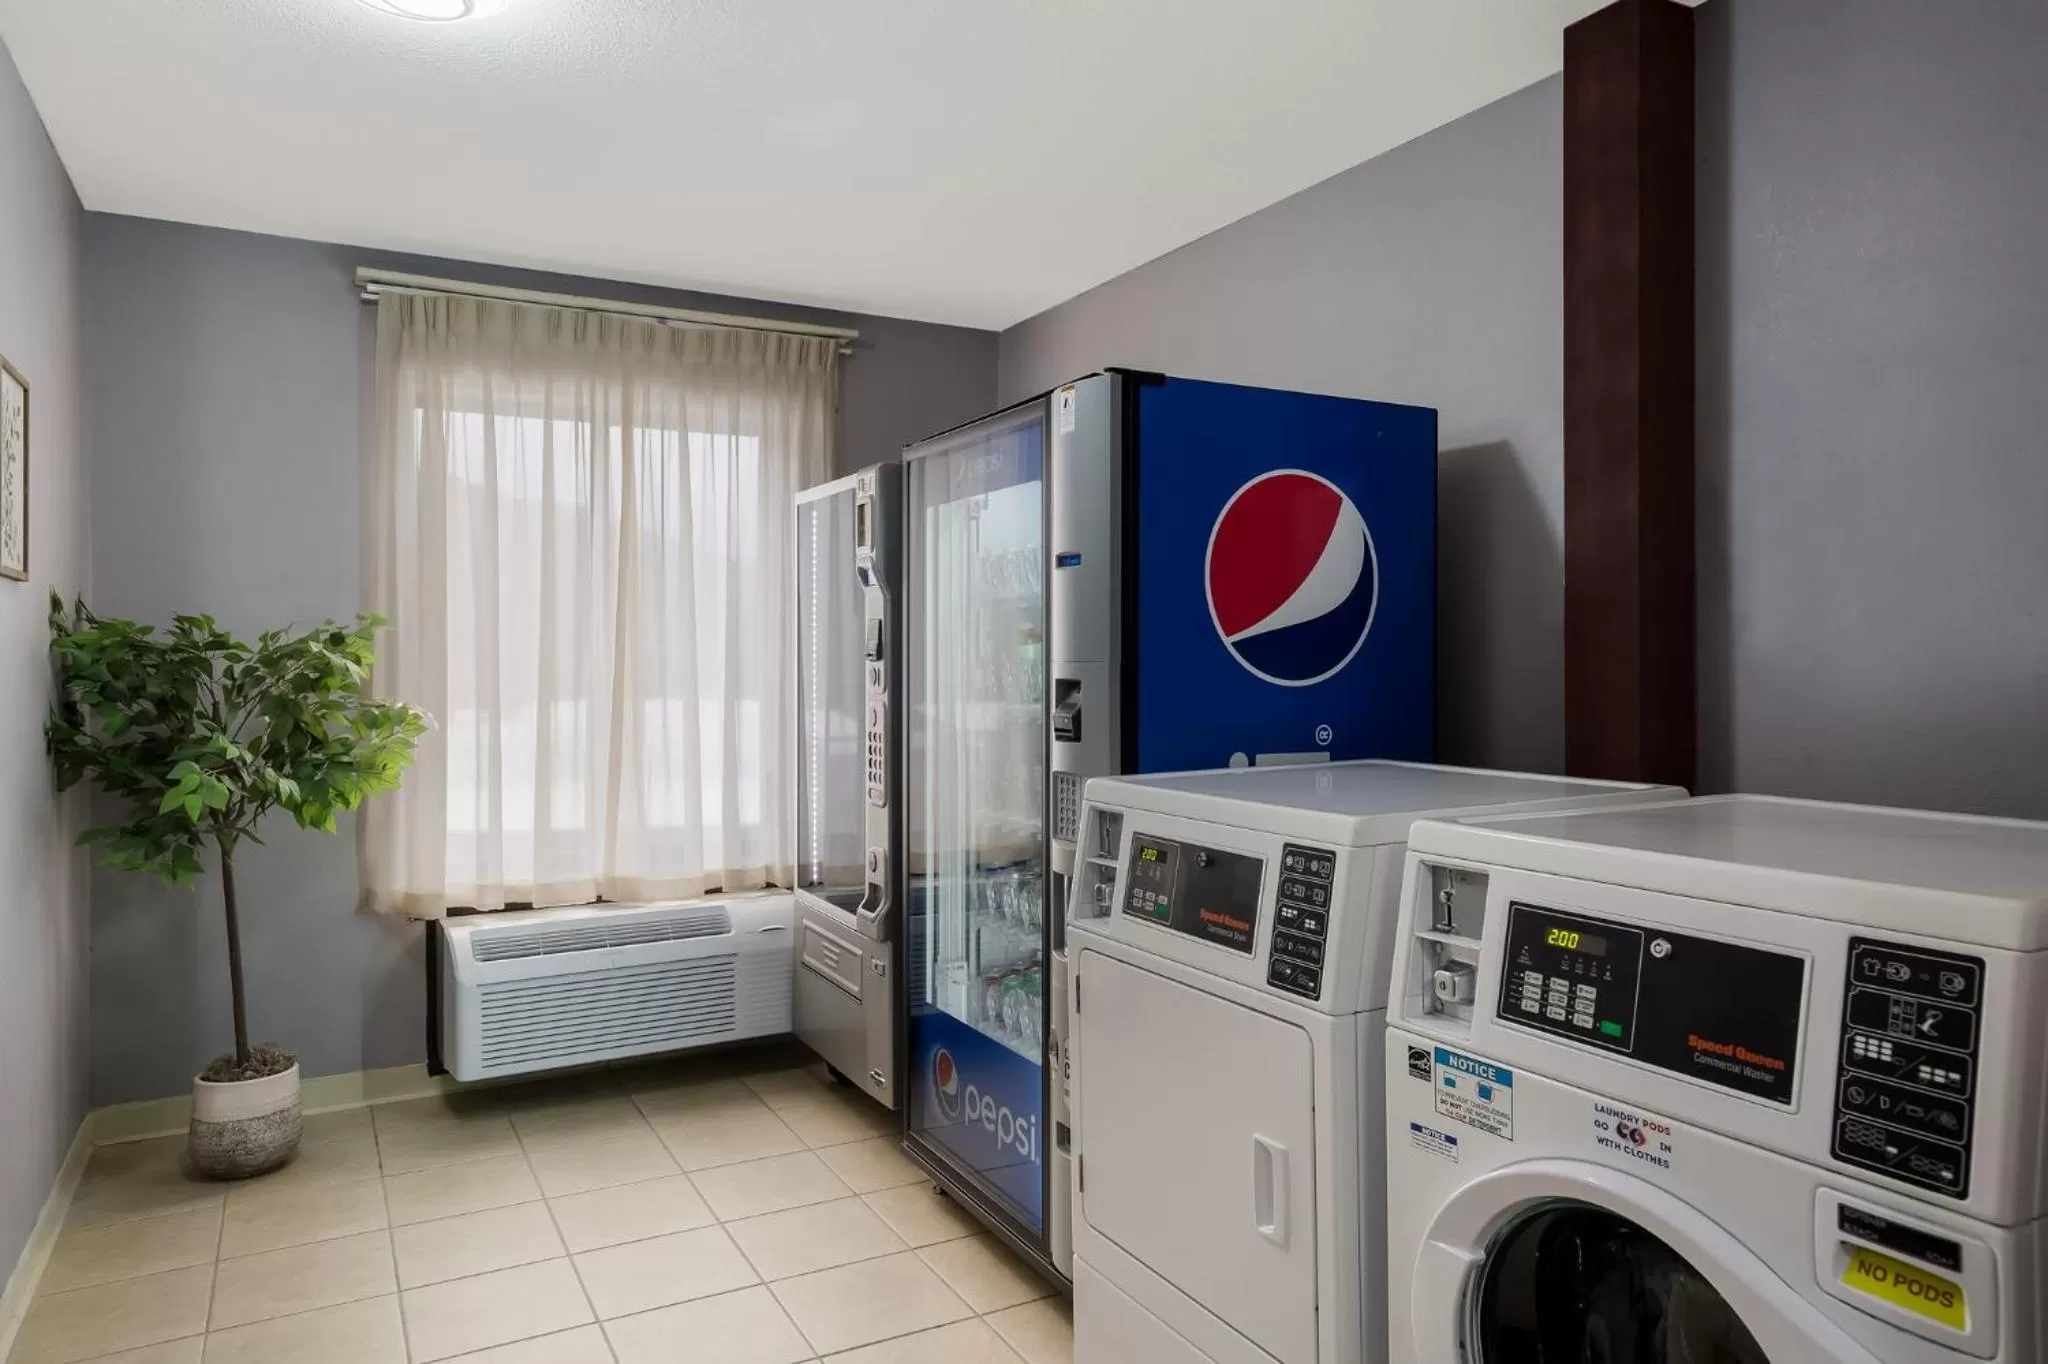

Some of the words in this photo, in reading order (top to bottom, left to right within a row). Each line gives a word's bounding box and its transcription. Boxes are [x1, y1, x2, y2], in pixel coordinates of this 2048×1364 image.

[1548, 928, 1579, 949] 2.00
[1449, 1055, 1496, 1080] NOTICE
[1688, 1033, 1733, 1057] Speed
[1735, 1046, 1785, 1071] Queen
[1693, 1052, 1741, 1074] Commercial
[1743, 1065, 1776, 1082] Washer
[964, 1084, 1036, 1161] pepsi
[1594, 1102, 1639, 1125] LAUNDRY
[1642, 1119, 1671, 1136] PODS
[1594, 1119, 1609, 1131] GO
[1659, 1142, 1672, 1153] IN
[1596, 1135, 1621, 1151] WITH
[1624, 1146, 1670, 1169] CLOTHES
[1857, 1260, 1888, 1283] NO
[1893, 1273, 1955, 1308] PODS
